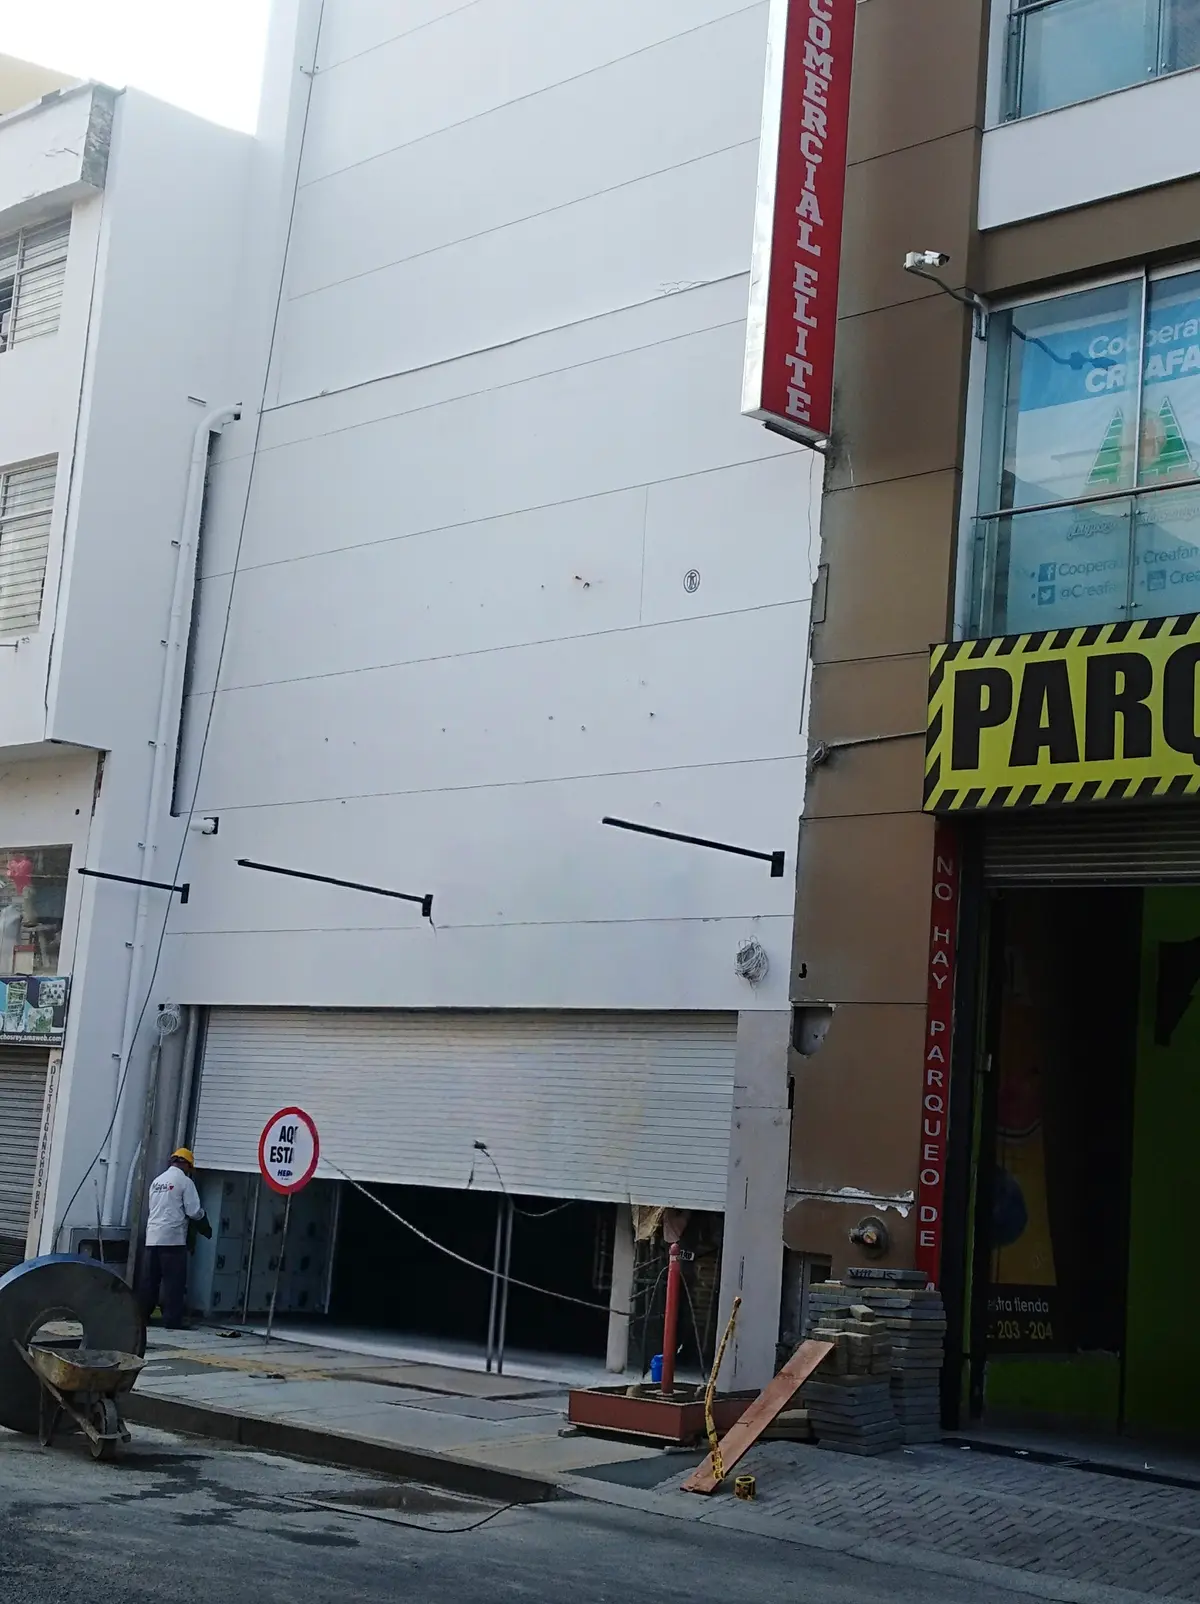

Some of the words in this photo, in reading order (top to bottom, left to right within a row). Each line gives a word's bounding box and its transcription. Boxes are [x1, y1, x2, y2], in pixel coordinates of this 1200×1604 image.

[795, 0, 834, 257] COMERCIAL
[785, 261, 819, 422] ELITE
[1085, 343, 1200, 393] CRAFA
[934, 855, 953, 901] NO
[931, 925, 950, 990] HAY
[37, 1065, 56, 1187] DISTRIGANCHOS
[920, 1020, 946, 1186] PARQUEO
[278, 1125, 299, 1144] AQ
[33, 1190, 41, 1219] REY
[919, 1206, 938, 1247] DE
[1013, 1296, 1049, 1313] tienda
[997, 1320, 1021, 1340] 203
